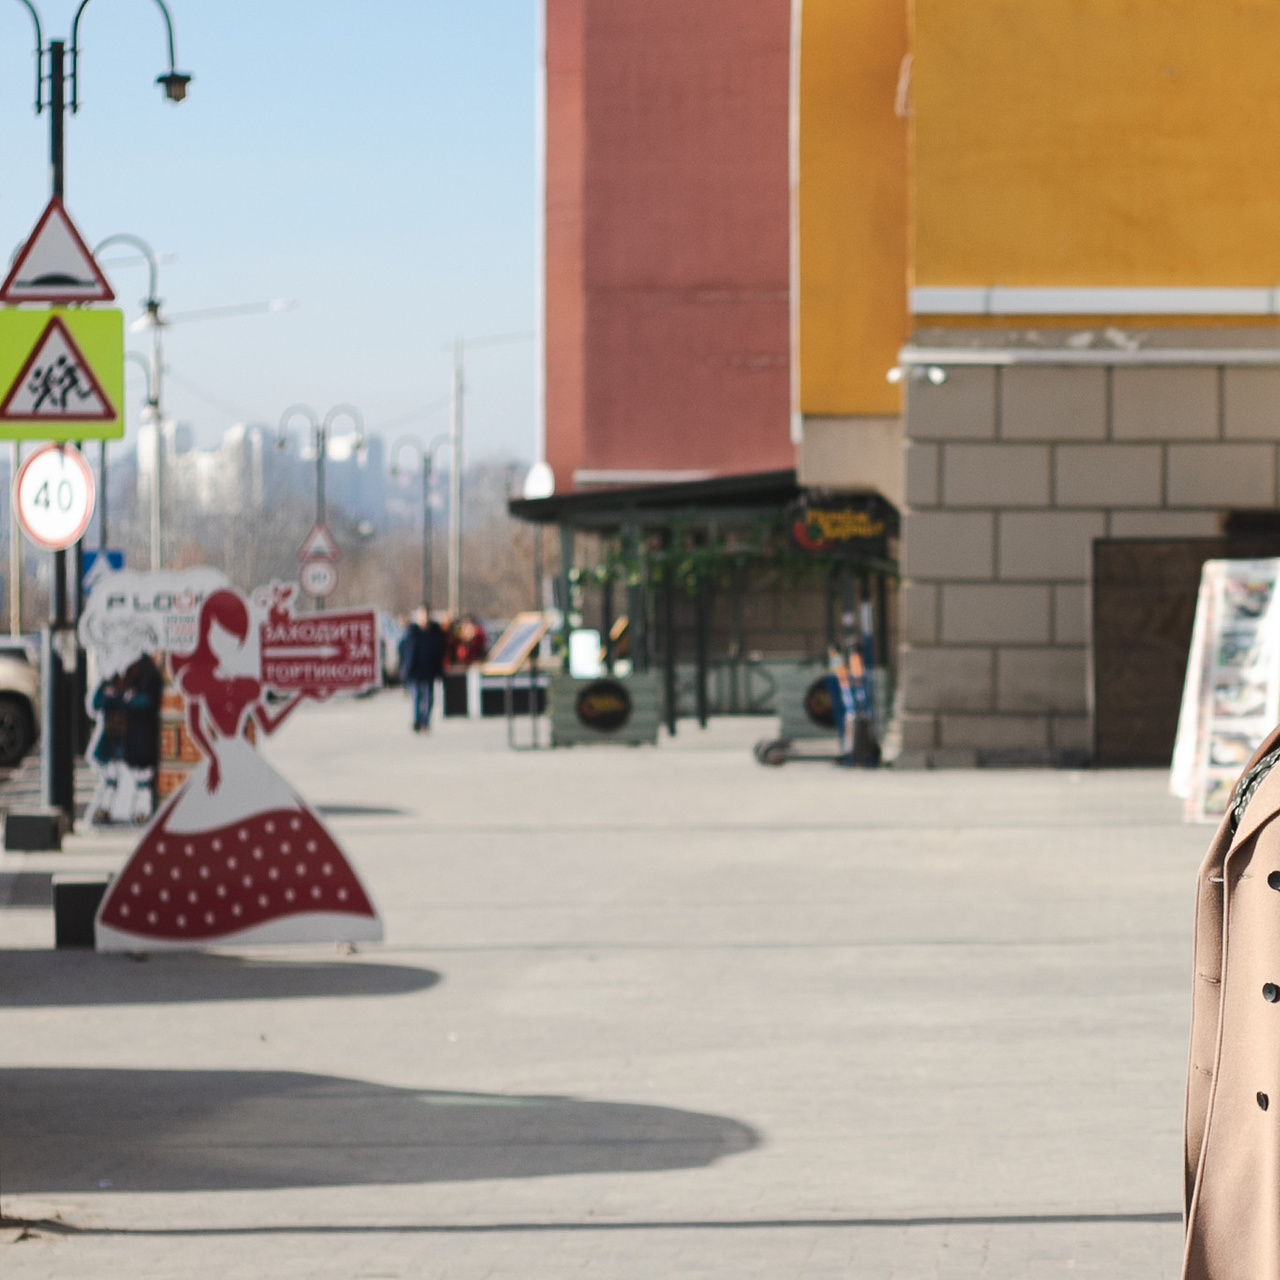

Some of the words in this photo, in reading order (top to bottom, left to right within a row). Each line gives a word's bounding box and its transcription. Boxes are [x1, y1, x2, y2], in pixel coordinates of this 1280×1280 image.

[33, 479, 73, 512] 40
[264, 621, 373, 643] ЗАХОДИТЕ
[347, 642, 373, 659] ЗА
